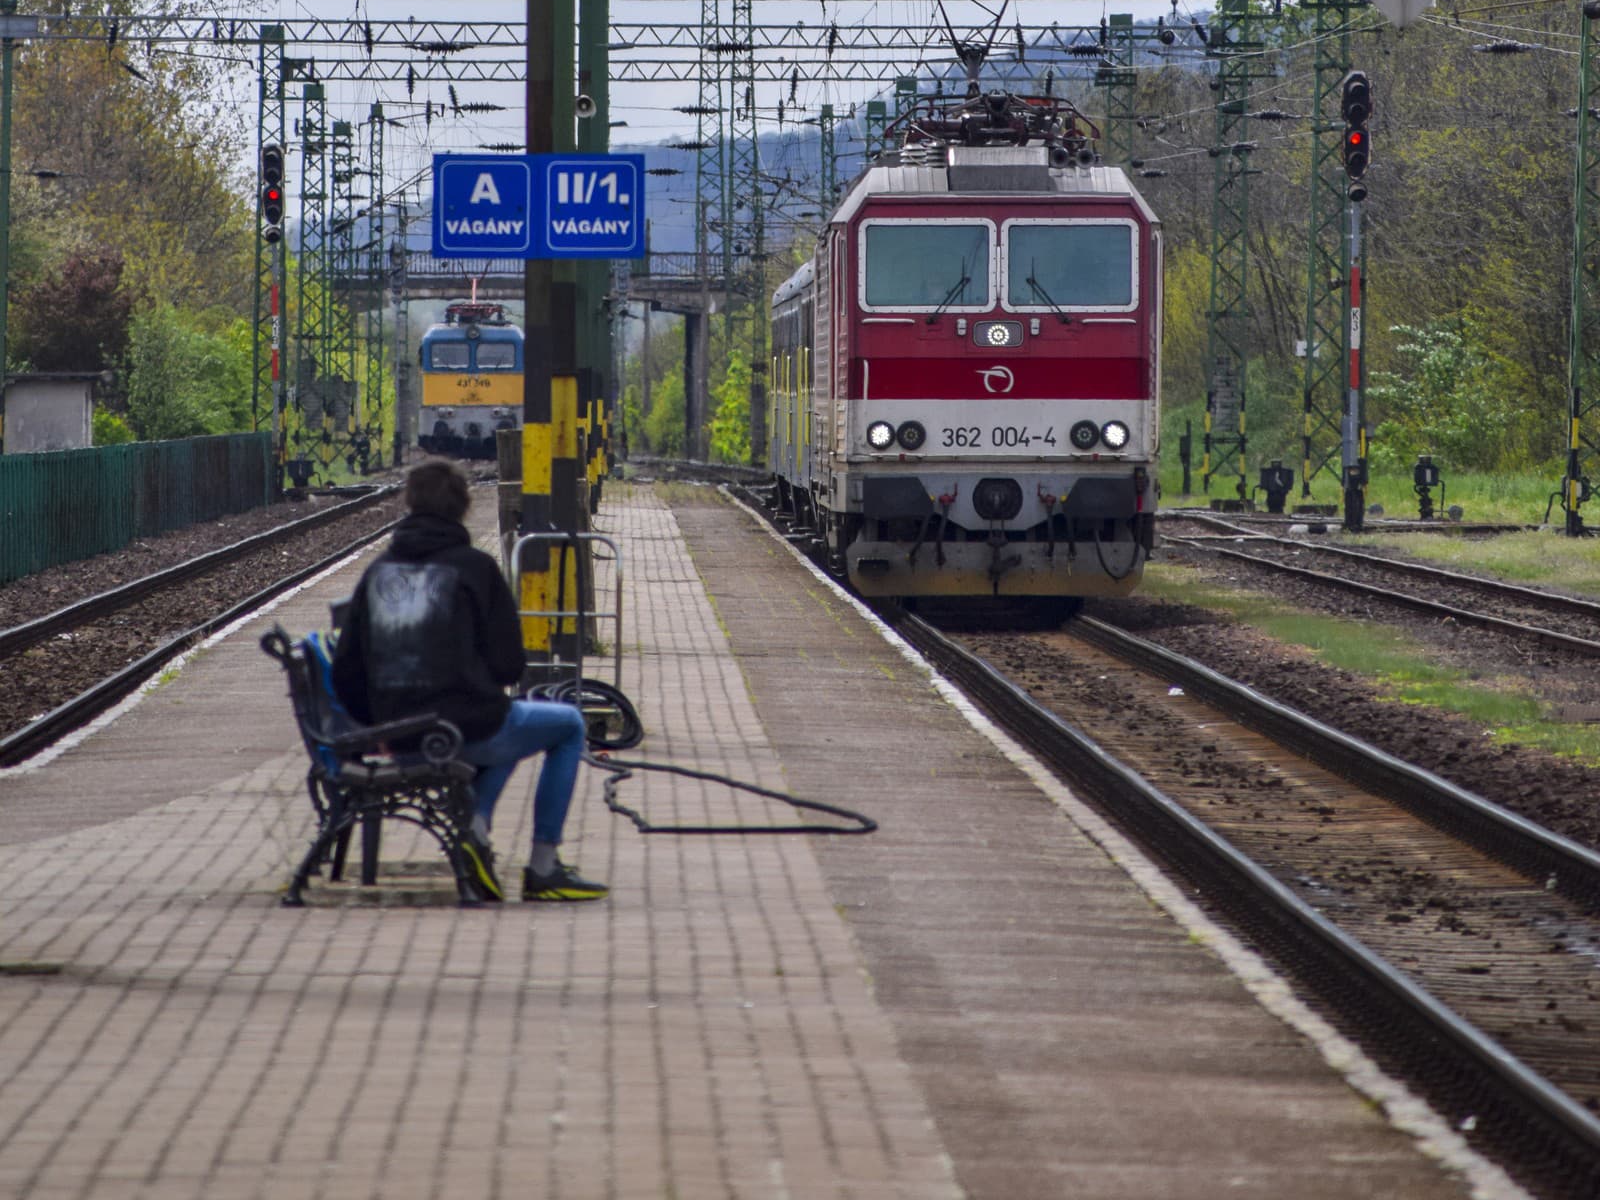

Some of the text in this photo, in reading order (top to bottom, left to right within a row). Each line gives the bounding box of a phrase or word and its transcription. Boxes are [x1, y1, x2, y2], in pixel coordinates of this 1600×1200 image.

[469, 172, 502, 205] A
[557, 172, 630, 205] II/1.
[445, 217, 524, 235] VÁGÁNY
[552, 217, 631, 235] VÁGÁNY
[942, 426, 1057, 448] 362 004-4
